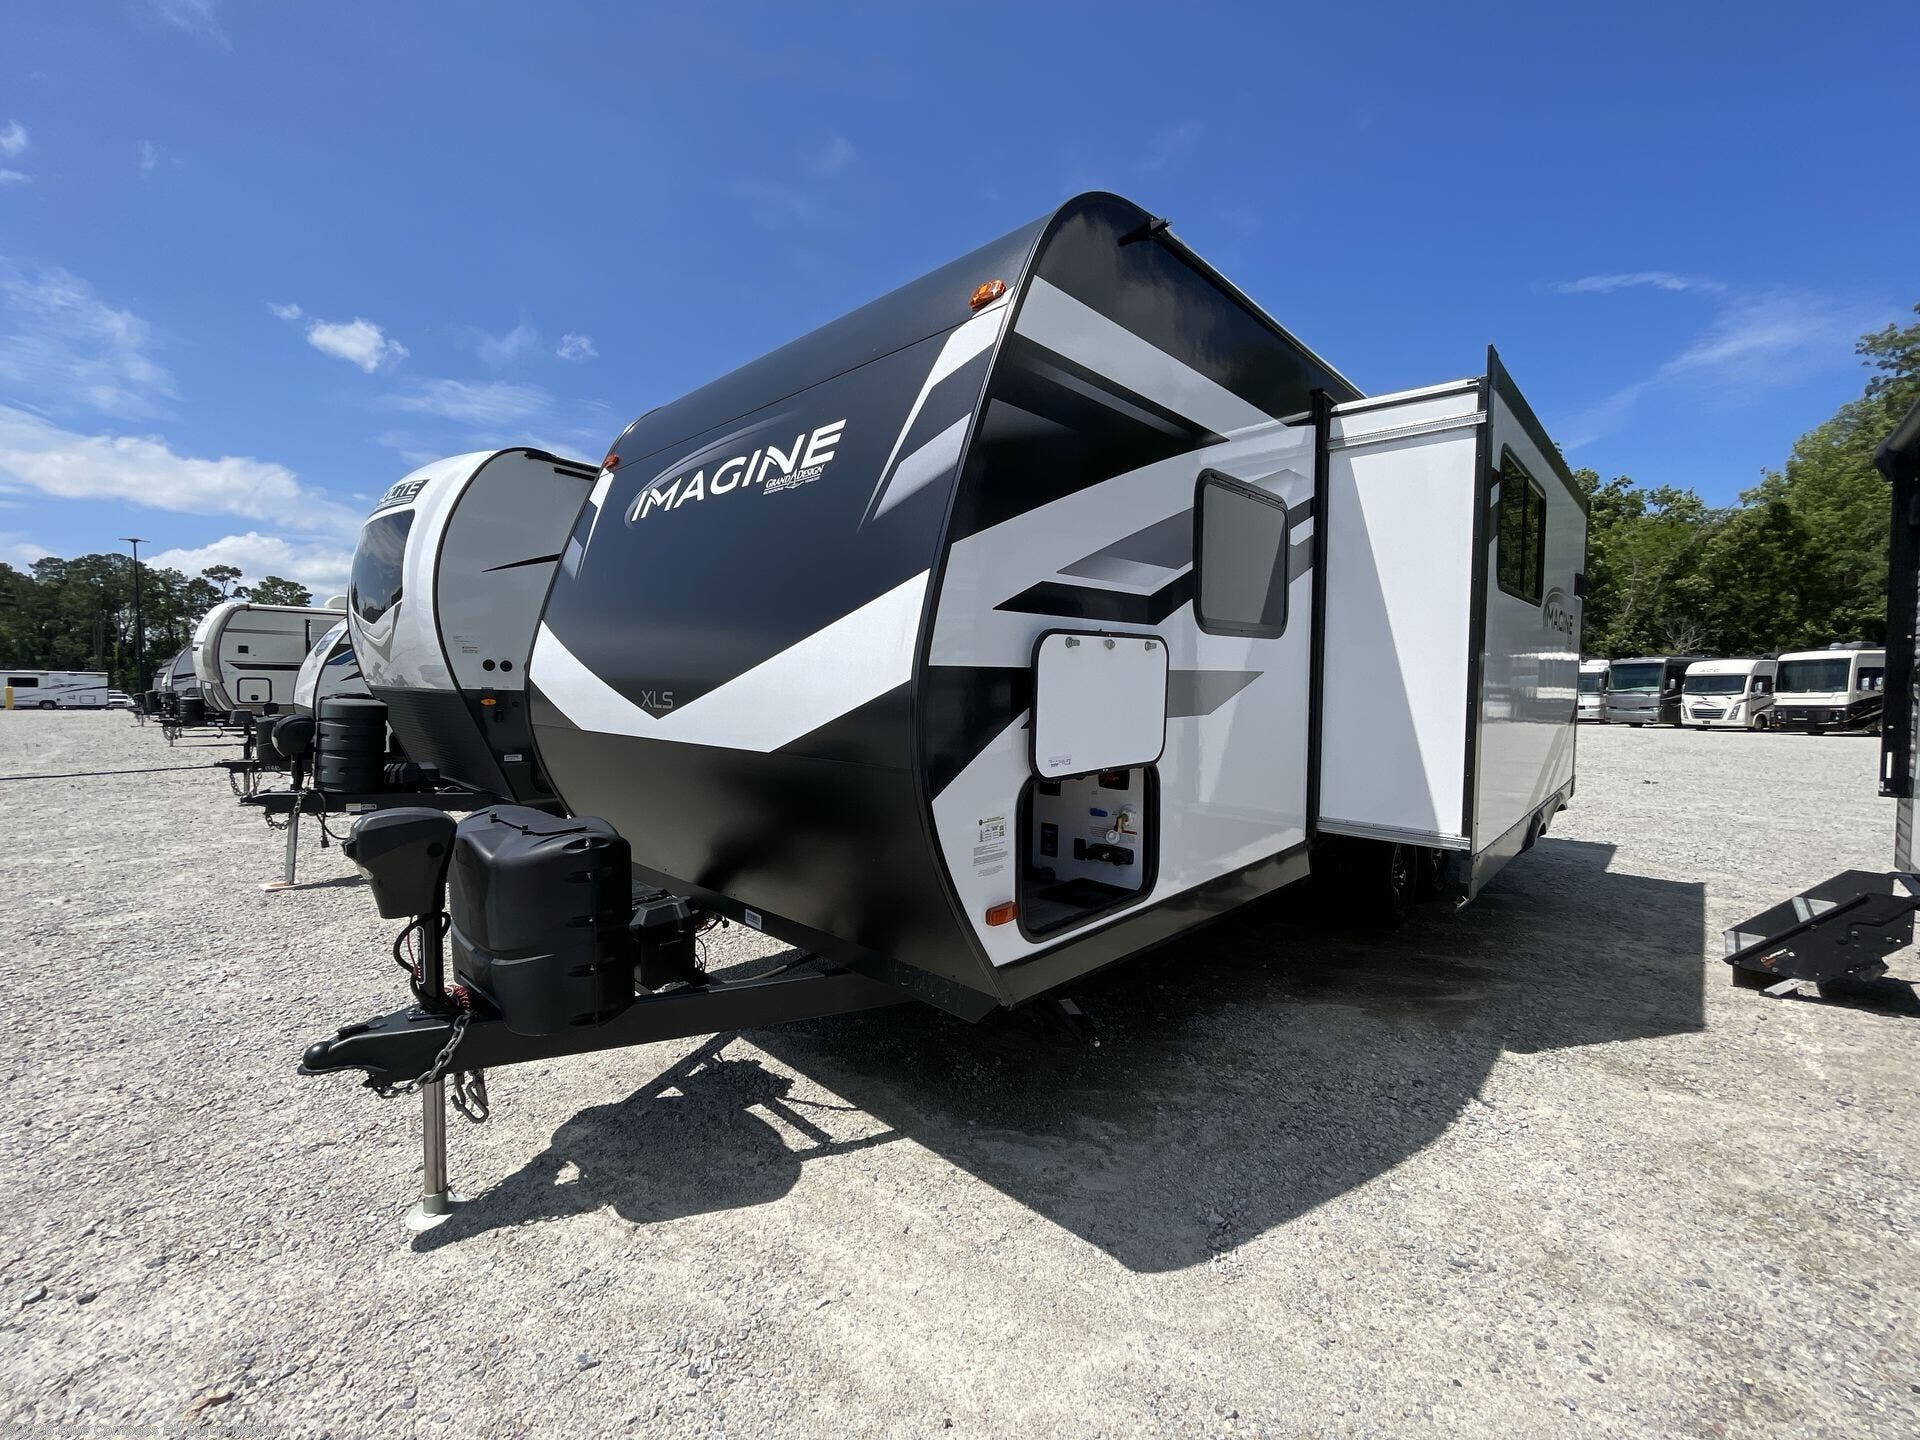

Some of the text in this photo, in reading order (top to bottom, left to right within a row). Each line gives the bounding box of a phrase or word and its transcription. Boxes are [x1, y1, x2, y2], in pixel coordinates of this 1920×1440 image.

[632, 419, 847, 521] IMAGINE
[766, 475, 791, 488] GRAND
[797, 464, 825, 480] DESIGN
[641, 690, 673, 708] XLS
